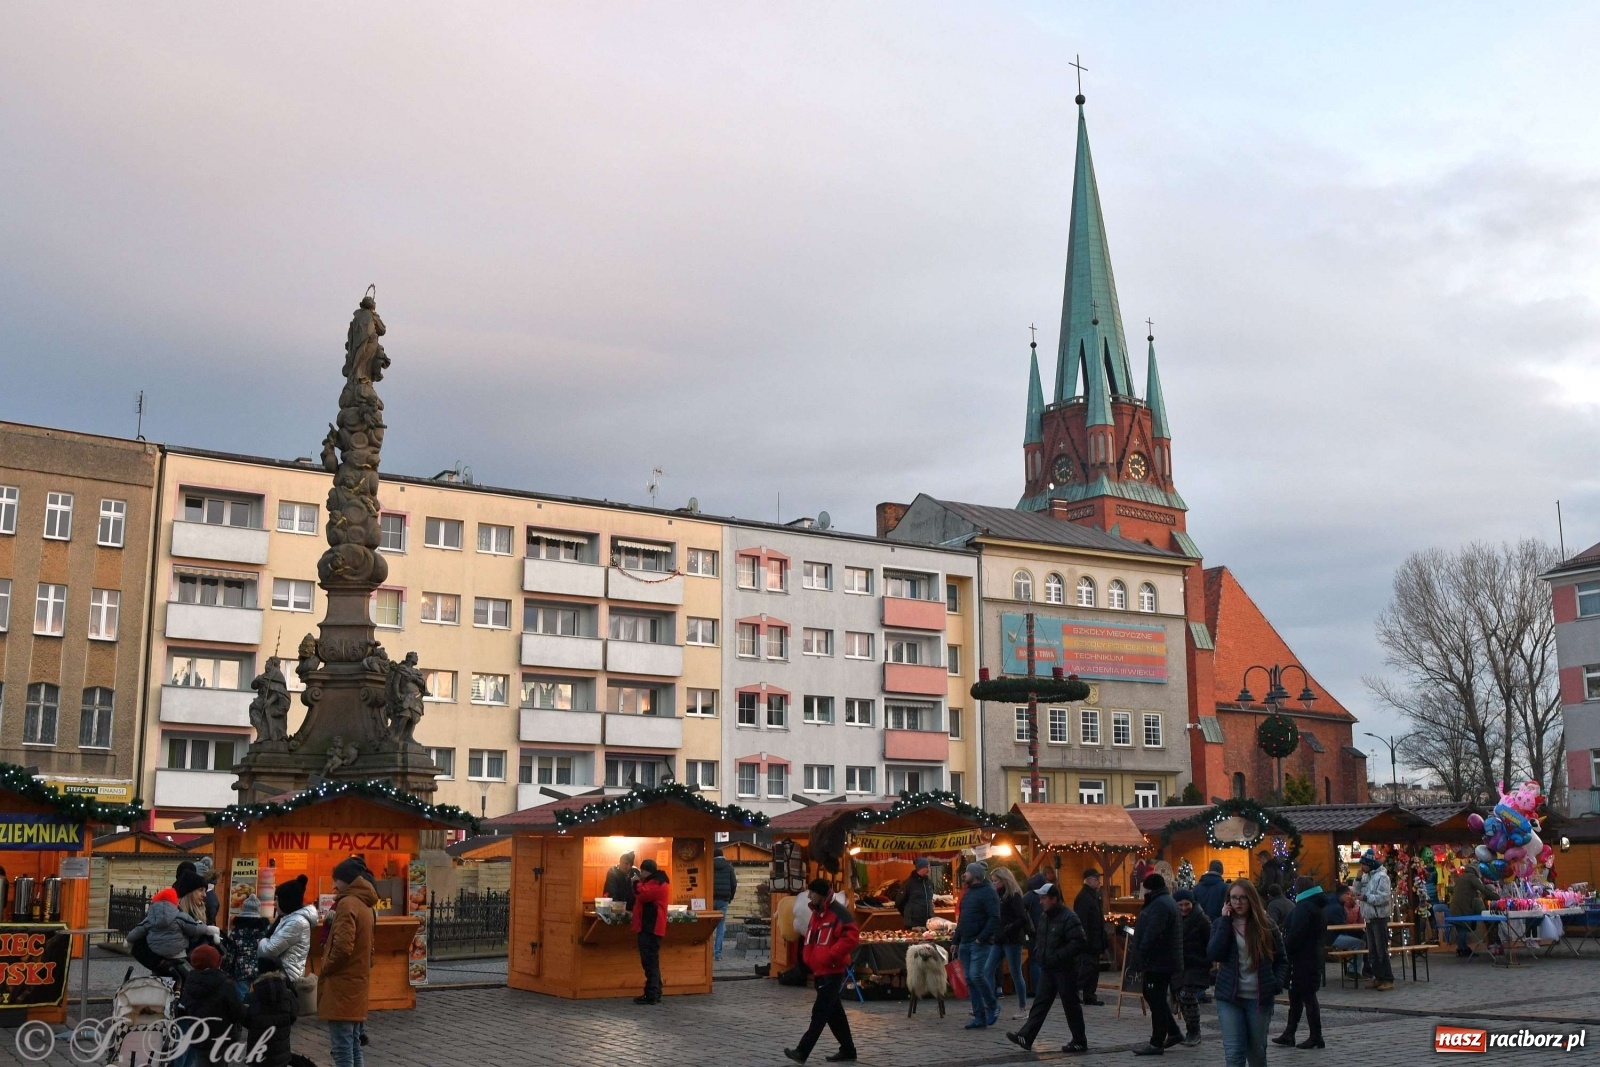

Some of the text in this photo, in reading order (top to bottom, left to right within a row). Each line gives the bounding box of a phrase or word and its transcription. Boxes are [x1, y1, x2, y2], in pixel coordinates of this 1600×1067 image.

[1106, 629, 1153, 640] MEDYCZNE
[1074, 652, 1124, 662] TECHNIKUM
[1126, 668, 1155, 676] WIEKU
[0, 823, 80, 843] ZIEMNIAK
[268, 832, 399, 851] MINI PĄCZKI
[882, 836, 938, 850] GÓRALSKIE
[940, 838, 947, 848] Z
[948, 833, 982, 848] GRILLA
